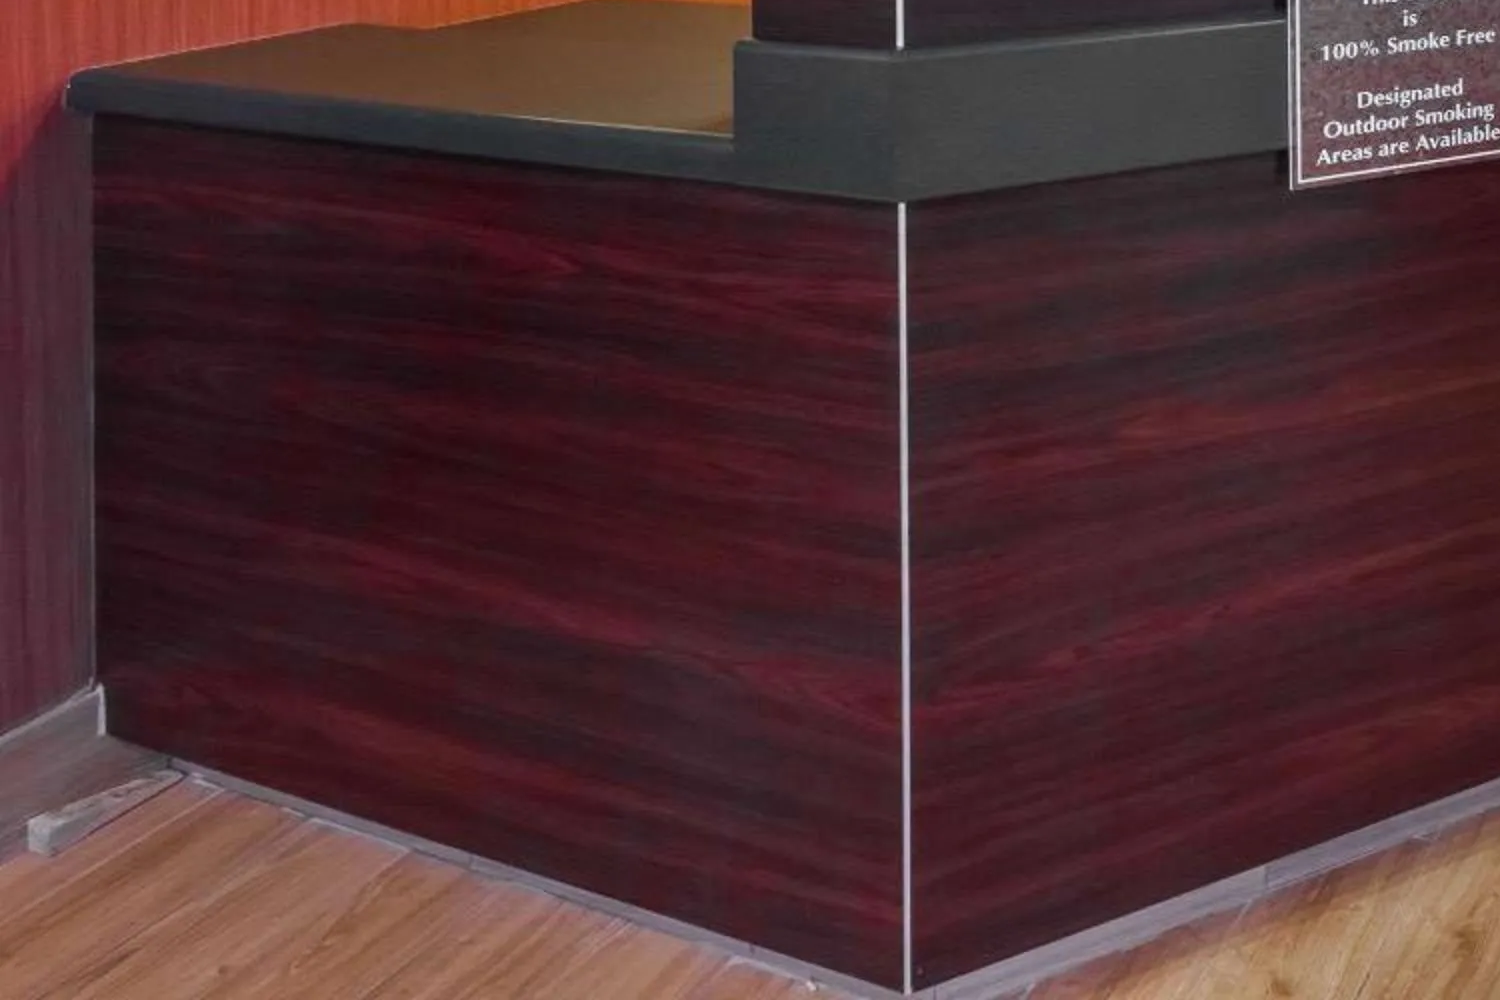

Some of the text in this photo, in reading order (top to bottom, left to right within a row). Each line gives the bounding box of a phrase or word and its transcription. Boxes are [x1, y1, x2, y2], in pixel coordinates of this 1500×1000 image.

[1402, 10, 1418, 27] is
[1321, 29, 1496, 61] 100% Smoke Free
[1357, 78, 1463, 109] Designated
[1323, 102, 1495, 139] Outdoor Smoking
[1315, 147, 1372, 166] Areas
[1378, 143, 1410, 157] are
